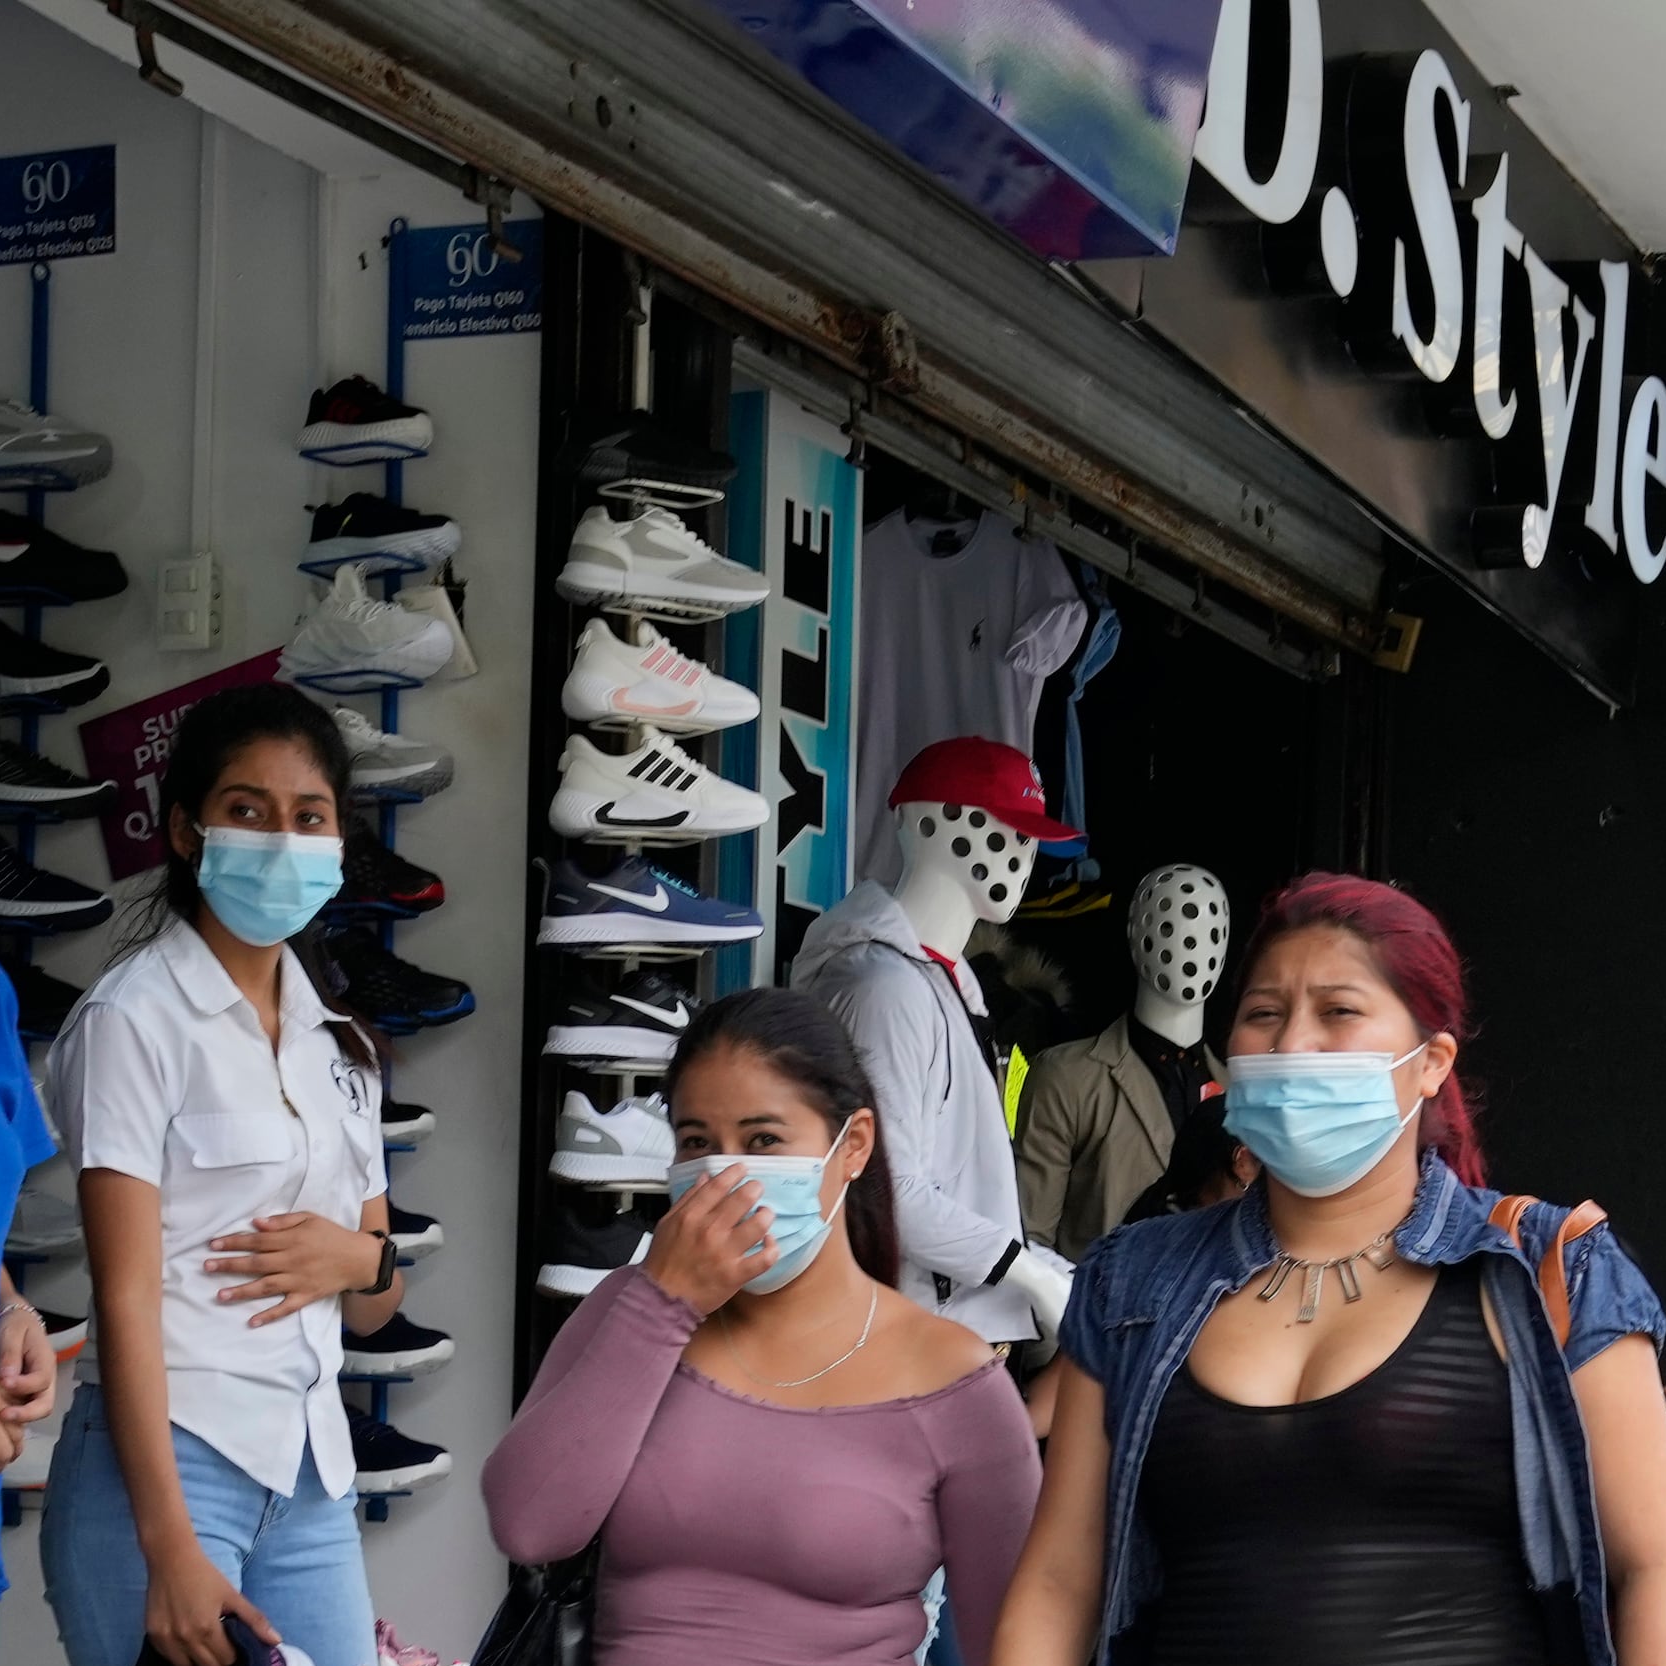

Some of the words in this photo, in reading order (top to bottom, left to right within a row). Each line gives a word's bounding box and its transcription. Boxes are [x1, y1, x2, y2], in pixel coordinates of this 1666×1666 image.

[25, 219, 67, 238] Tarjeta
[36, 238, 85, 259] Efectivo
[414, 297, 447, 314] Pago
[448, 291, 492, 312] Tarjeta
[458, 314, 510, 332] Efectivo
